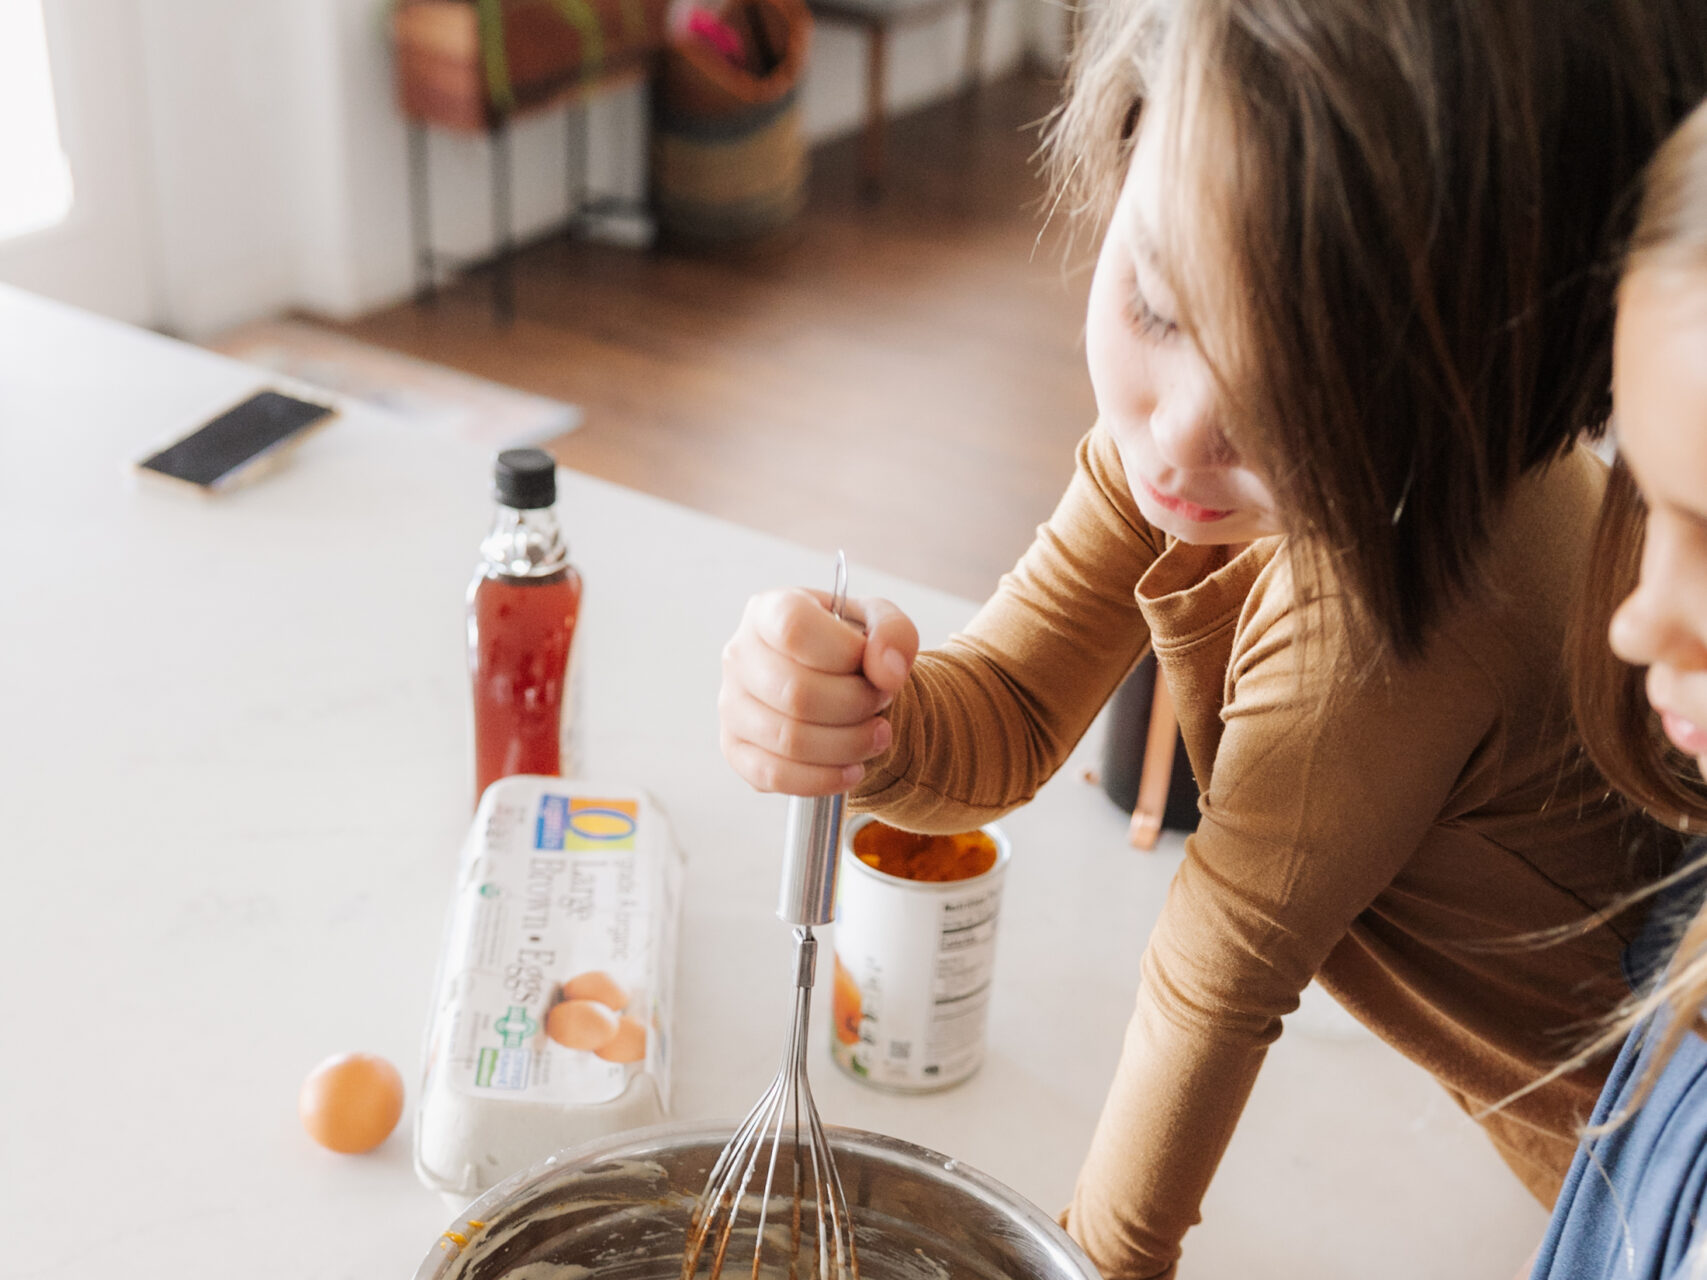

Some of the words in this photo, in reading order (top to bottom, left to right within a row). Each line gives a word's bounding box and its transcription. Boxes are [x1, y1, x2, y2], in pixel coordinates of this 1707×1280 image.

[521, 857, 567, 930] Brown
[560, 859, 609, 920] Large
[503, 948, 555, 1005] Eggs
